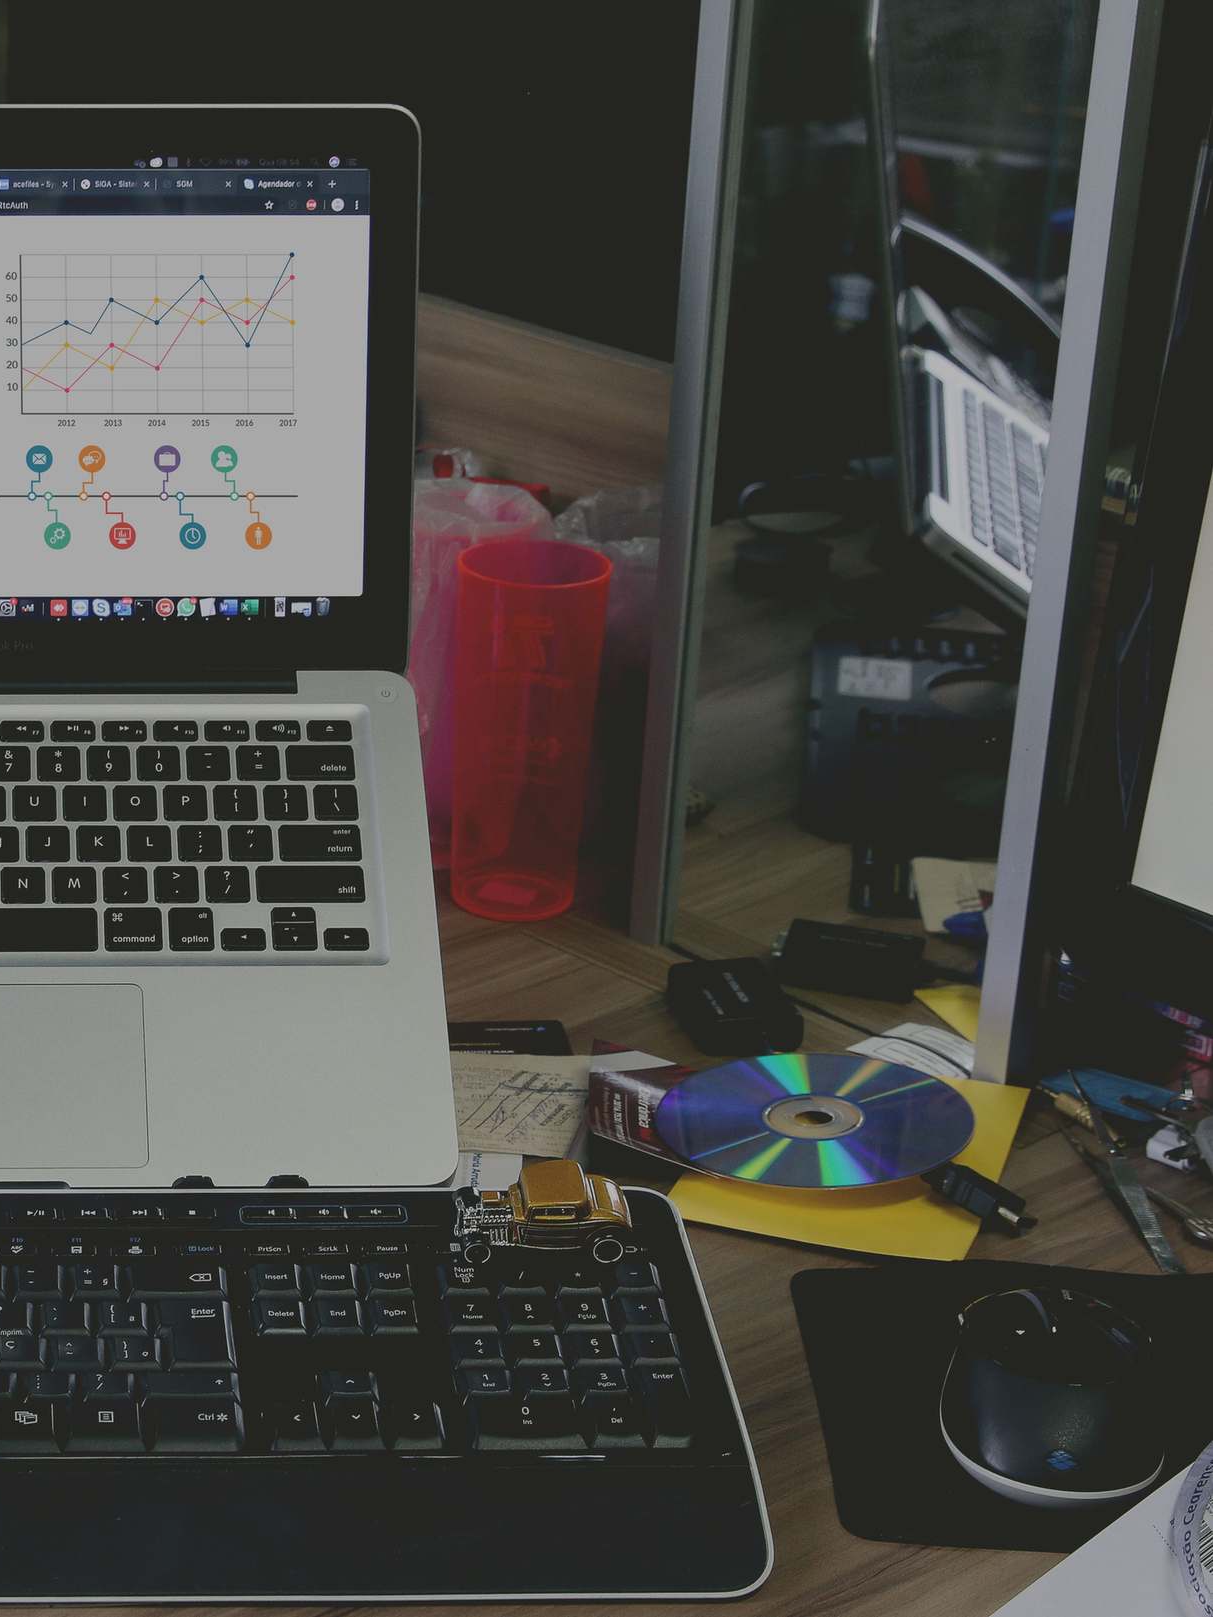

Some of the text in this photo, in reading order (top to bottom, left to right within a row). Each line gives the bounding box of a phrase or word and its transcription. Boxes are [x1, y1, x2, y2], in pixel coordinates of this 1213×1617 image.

[257, 180, 295, 189] Agendador
[5, 271, 18, 281] 60
[5, 294, 18, 303] 50
[5, 315, 18, 325] 40
[6, 337, 19, 347] 30
[6, 360, 19, 369] 20
[7, 382, 19, 393] 10
[57, 418, 298, 428] 2012 2013 2014 2015 2016 2017
[320, 764, 347, 772] delete
[29, 796, 40, 807] U
[129, 796, 141, 807] O
[181, 795, 190, 806] P
[44, 836, 51, 847] J
[94, 836, 104, 847] K
[146, 836, 154, 847] L
[327, 845, 353, 853] return
[18, 878, 28, 889] N
[67, 877, 81, 889] M
[338, 885, 356, 894] shift
[112, 934, 156, 943] command
[181, 935, 209, 944] option
[379, 1272, 401, 1280] PgUp
[191, 1307, 215, 1315] Enter
[384, 1309, 407, 1317] PgDn
[198, 1412, 215, 1421] Ctrl
